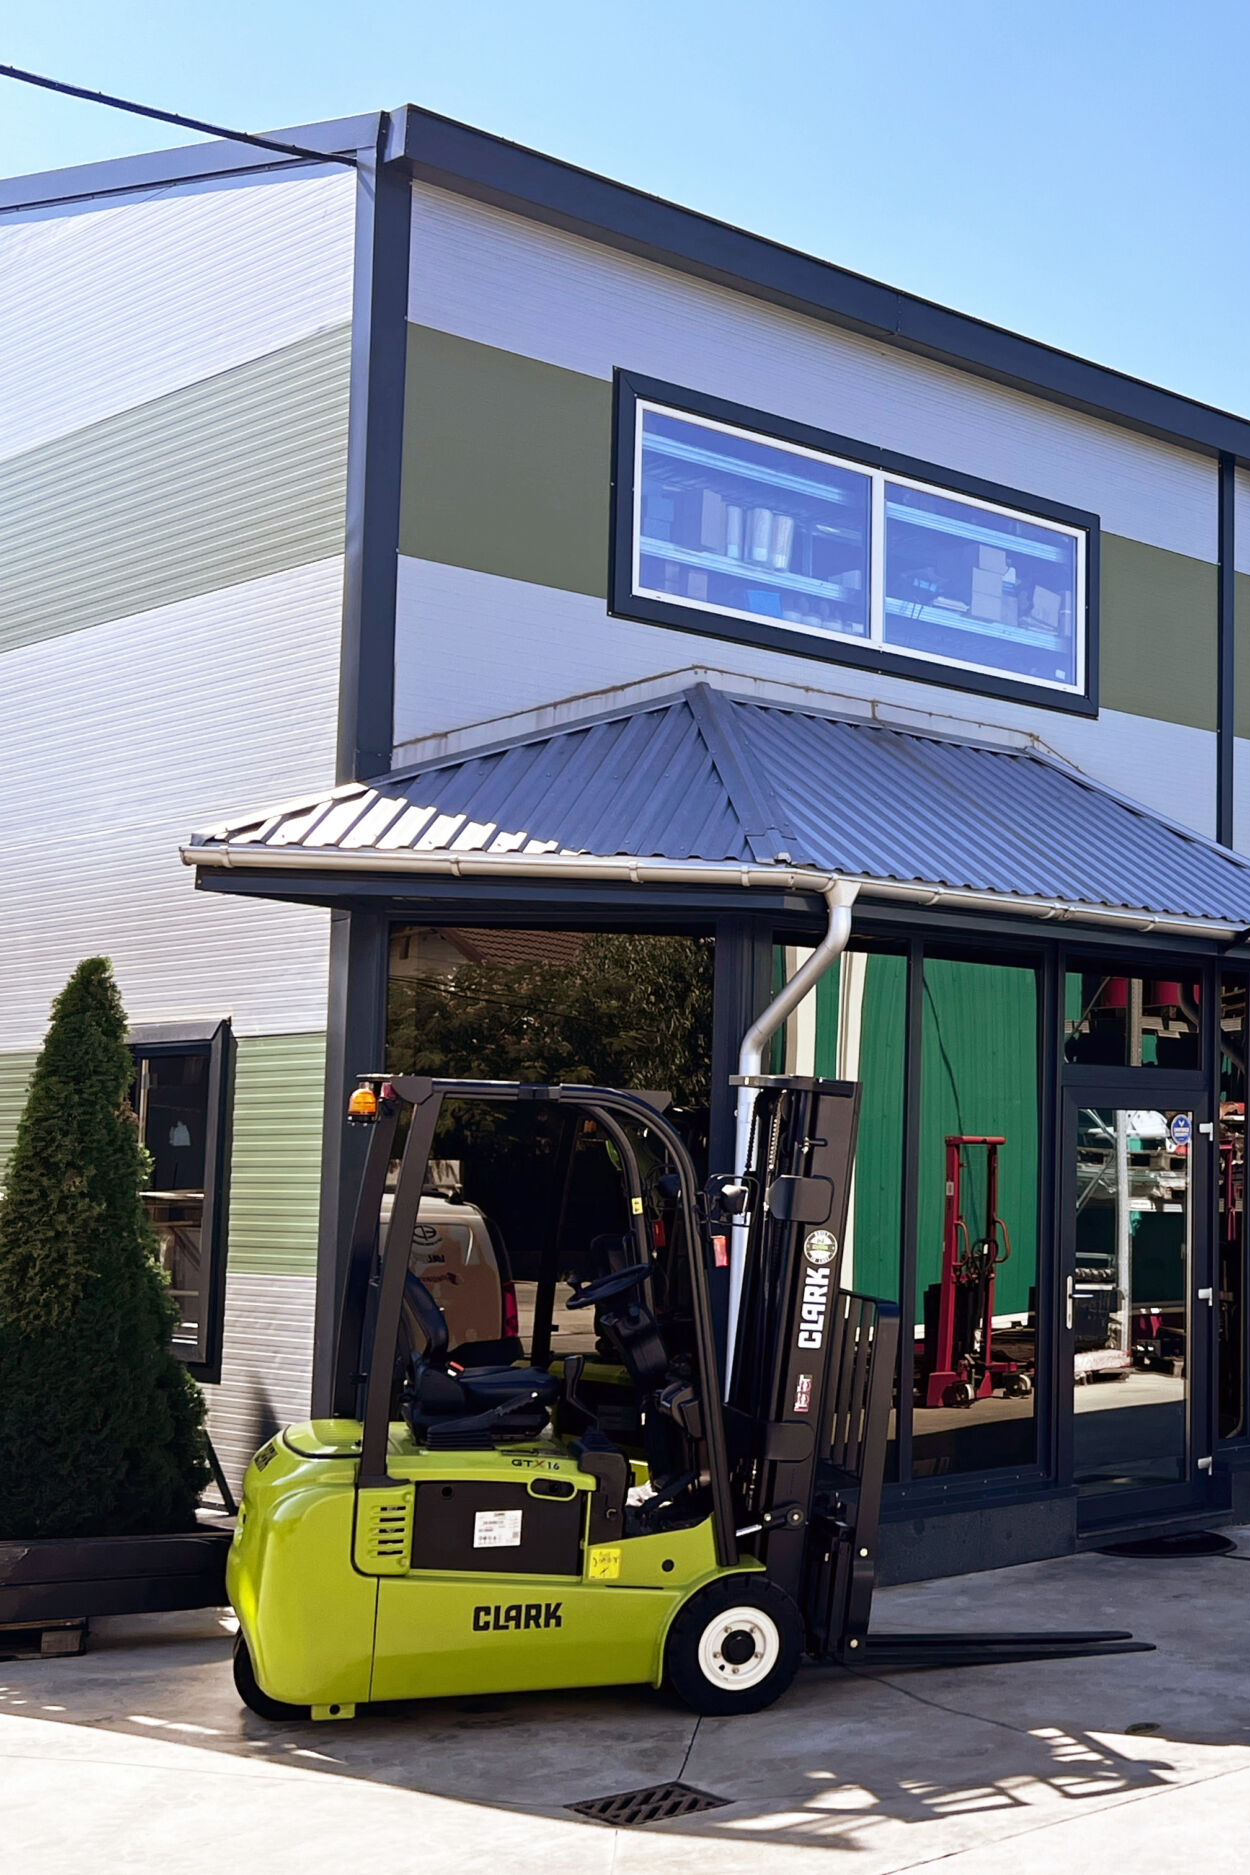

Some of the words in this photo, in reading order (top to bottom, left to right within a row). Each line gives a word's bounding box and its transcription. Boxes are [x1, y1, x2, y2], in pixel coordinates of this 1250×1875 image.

[797, 1266, 831, 1350] CLARK
[511, 1458, 544, 1469] GTX
[547, 1461, 560, 1471] 16
[472, 1602, 563, 1632] CLARK
